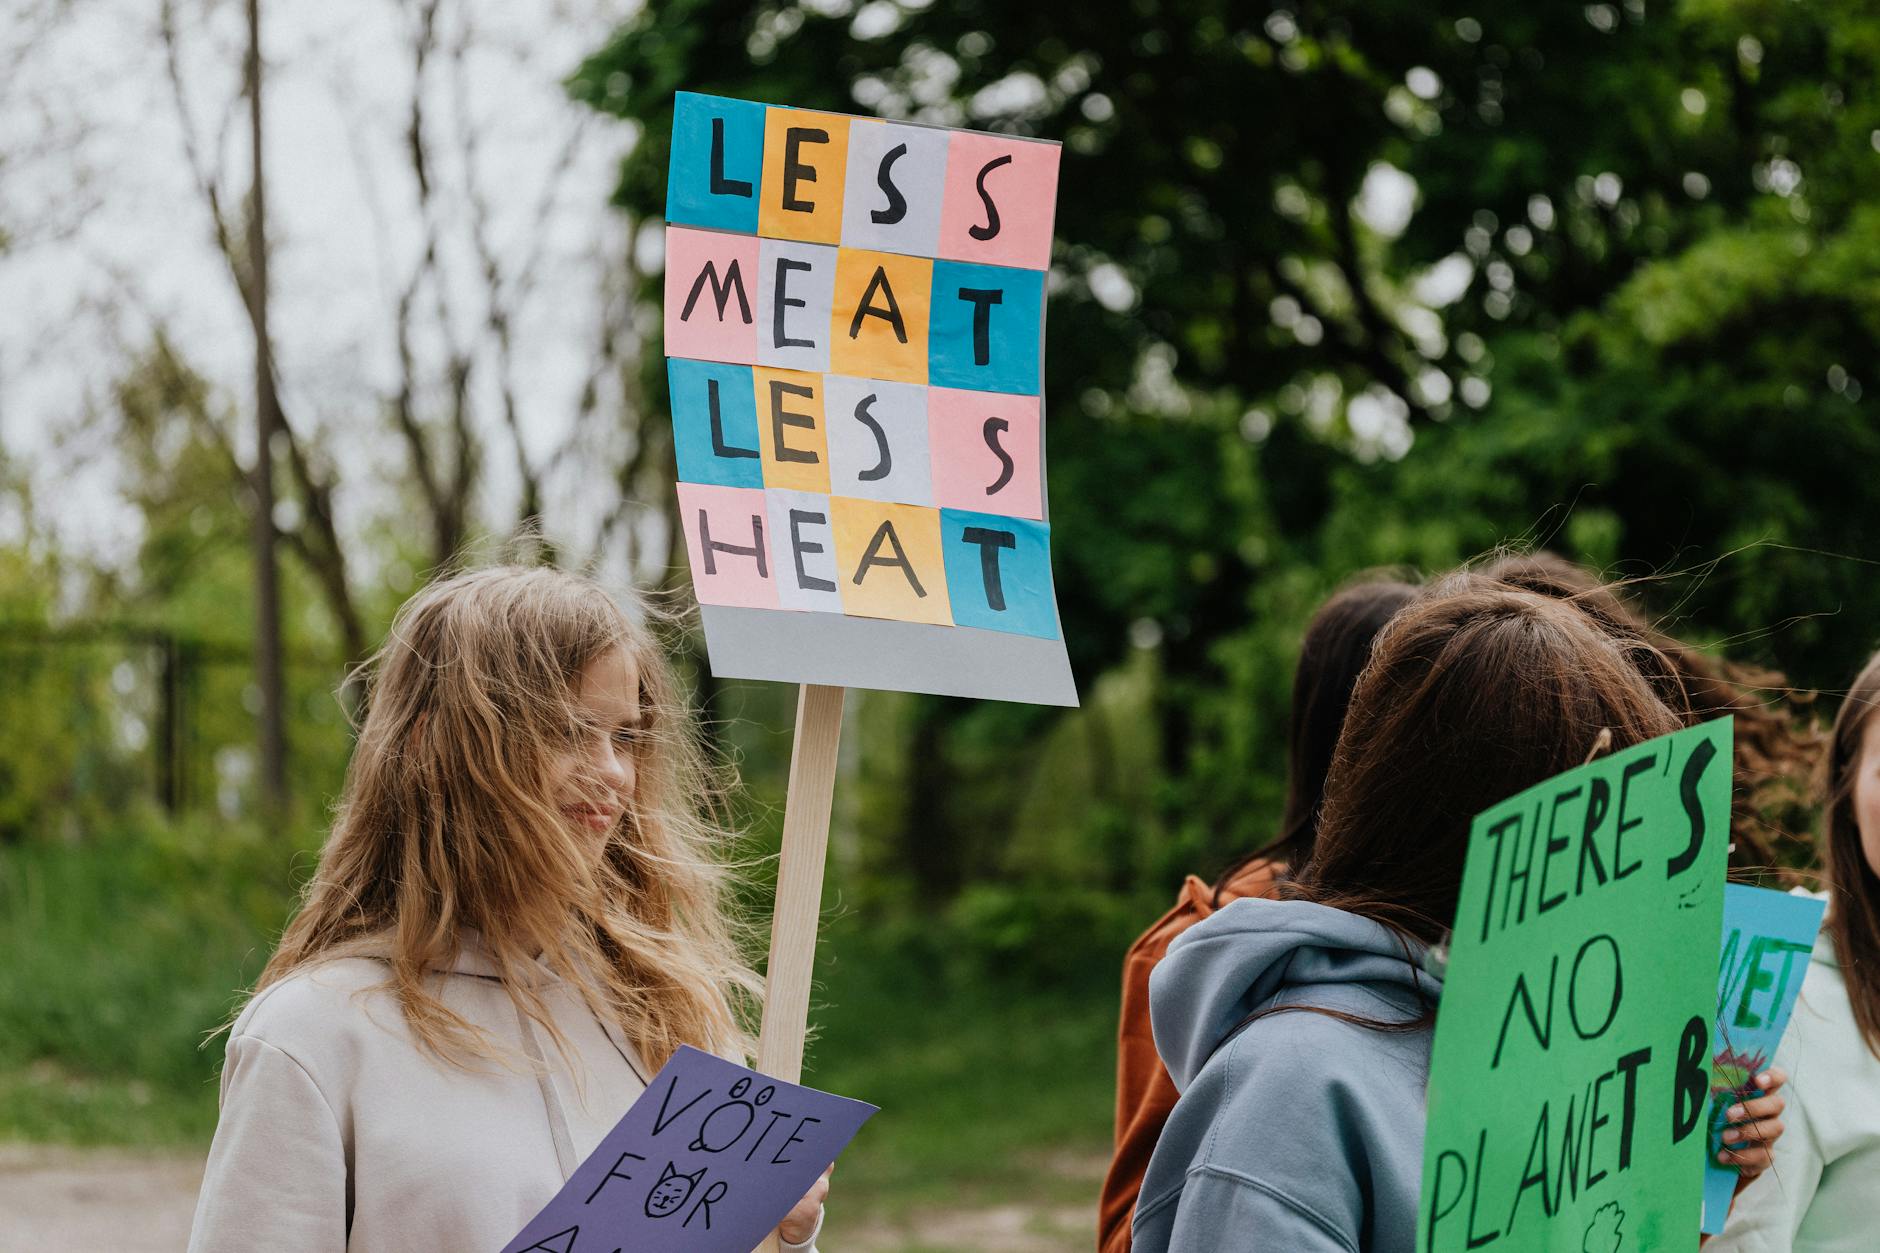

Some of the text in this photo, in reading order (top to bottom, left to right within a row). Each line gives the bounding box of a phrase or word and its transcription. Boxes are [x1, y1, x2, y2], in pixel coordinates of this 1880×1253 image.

[710, 118, 1012, 240] LESS
[681, 258, 1004, 366] MEAT
[707, 379, 1015, 495] LESS
[699, 508, 1016, 611] HEAT
[1481, 737, 1717, 942] THERE'S
[1491, 934, 1624, 1069] NO
[652, 1076, 821, 1164] VOTE
[1427, 1014, 1710, 1253] PLANET B
[585, 1152, 728, 1230] FOR
